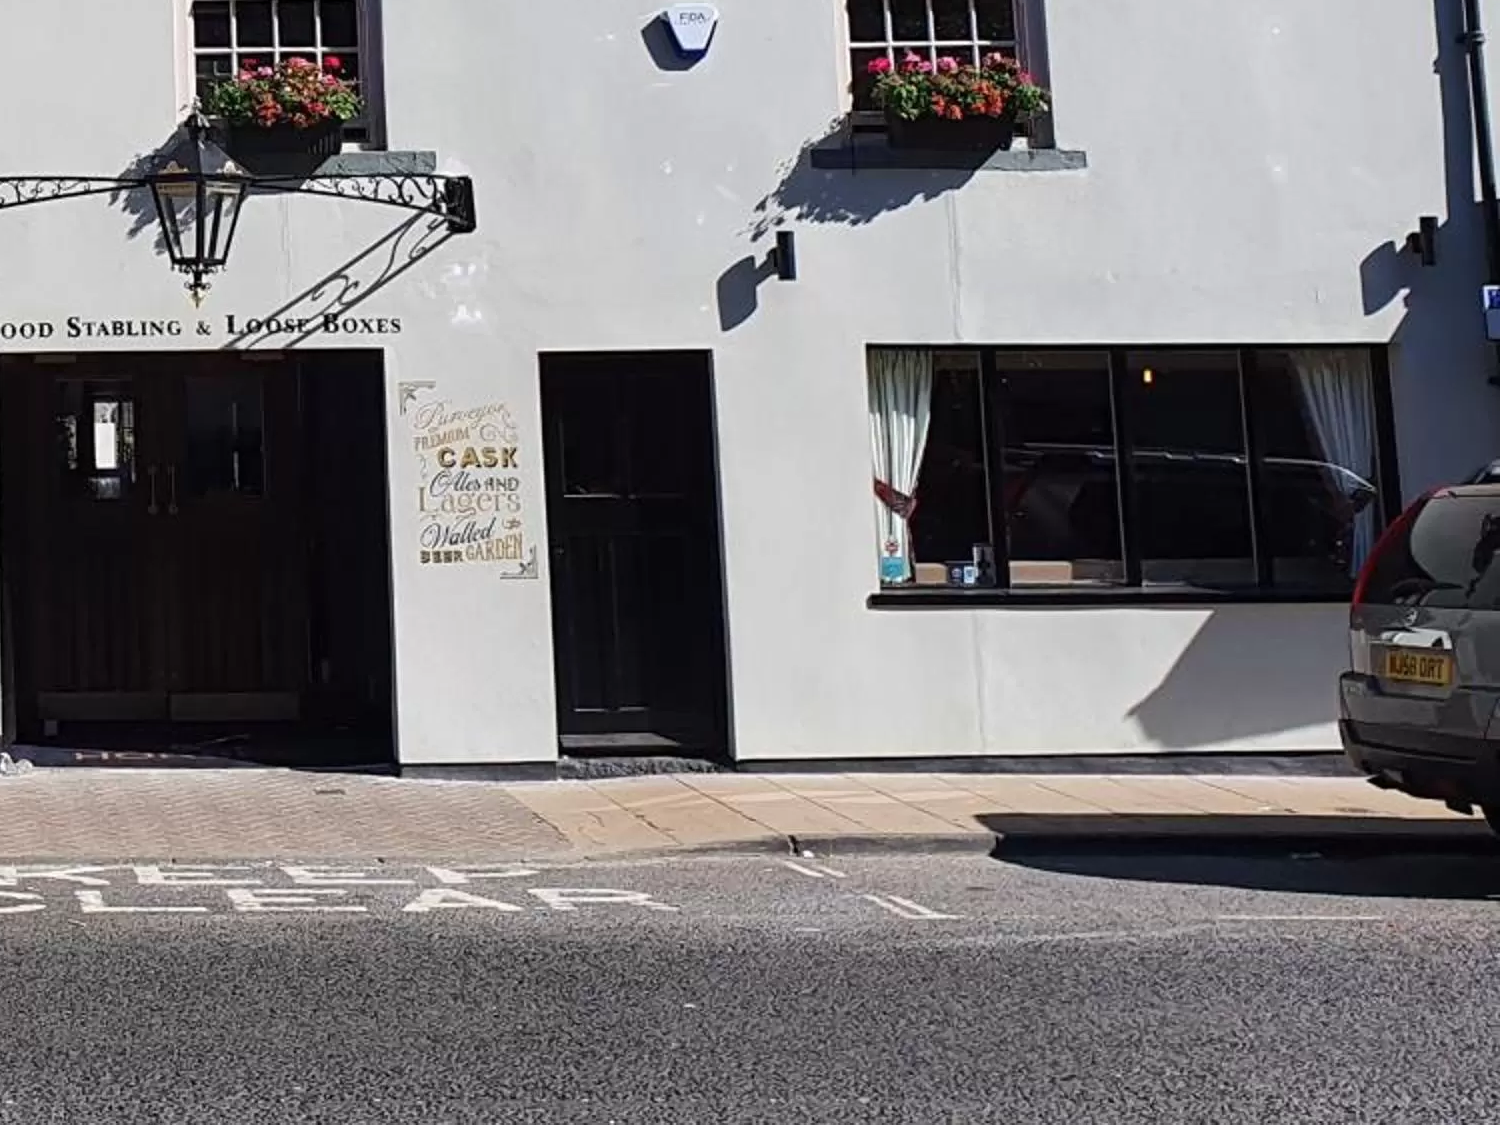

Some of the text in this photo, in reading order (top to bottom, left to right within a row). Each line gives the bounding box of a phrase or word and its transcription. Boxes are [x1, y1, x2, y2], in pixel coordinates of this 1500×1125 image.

[196, 321, 212, 336] &
[437, 446, 518, 469] CASK
[484, 476, 520, 492] AND
[418, 486, 522, 516] Lagers
[420, 517, 497, 549] Walled
[465, 533, 523, 561] GARDEN
